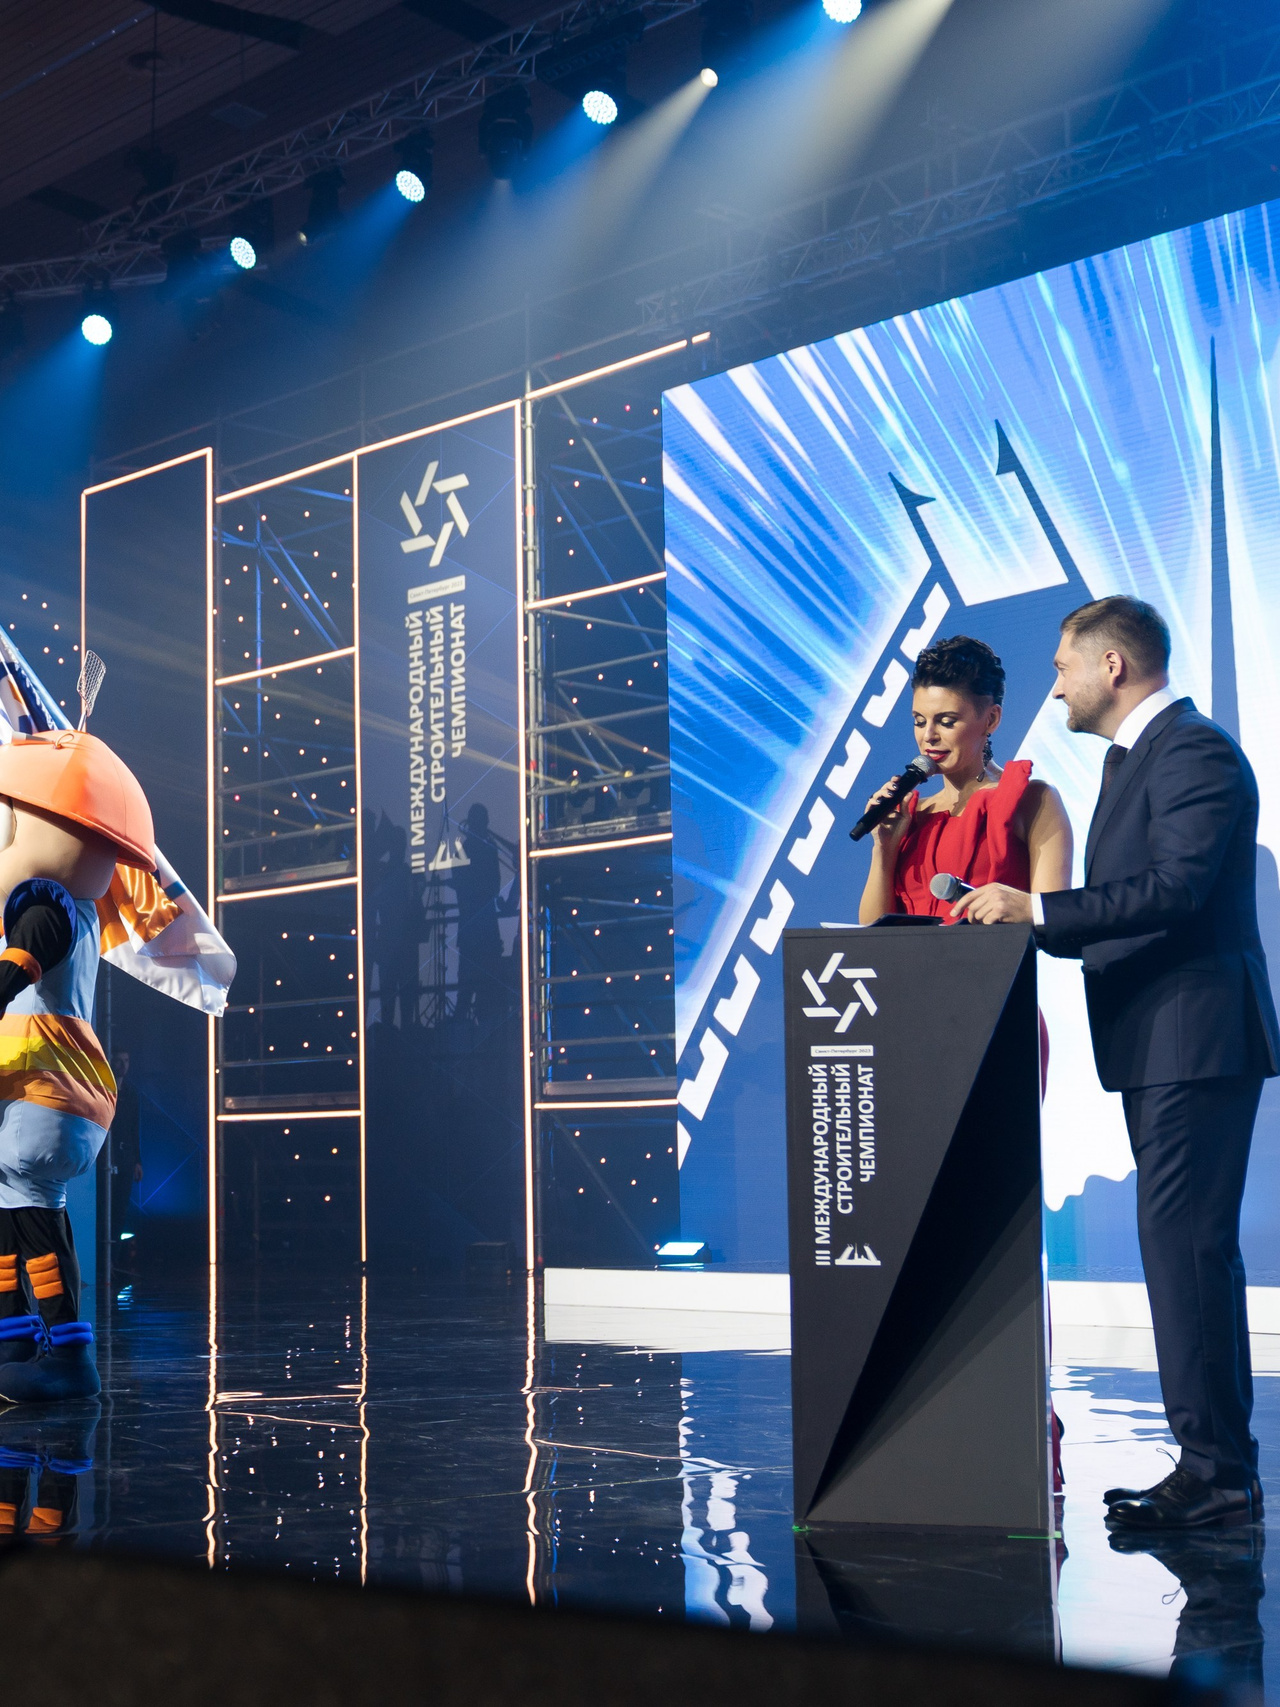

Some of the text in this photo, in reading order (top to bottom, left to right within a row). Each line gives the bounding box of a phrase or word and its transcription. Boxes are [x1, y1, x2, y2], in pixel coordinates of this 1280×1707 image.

[405, 610, 427, 846] МЕЖДУНАРОДНЫЙ
[426, 605, 445, 803] СТРОИТЕЛЬНЫЙ
[450, 602, 466, 758] ЧЕМПИОНАТ
[807, 1064, 833, 1245] МЕЖДУНАРОДНЫЙ
[830, 1063, 854, 1215] СТРОИТЕЛЬНЫЙ
[857, 1063, 876, 1183] ЧЕМПИОНАТ
